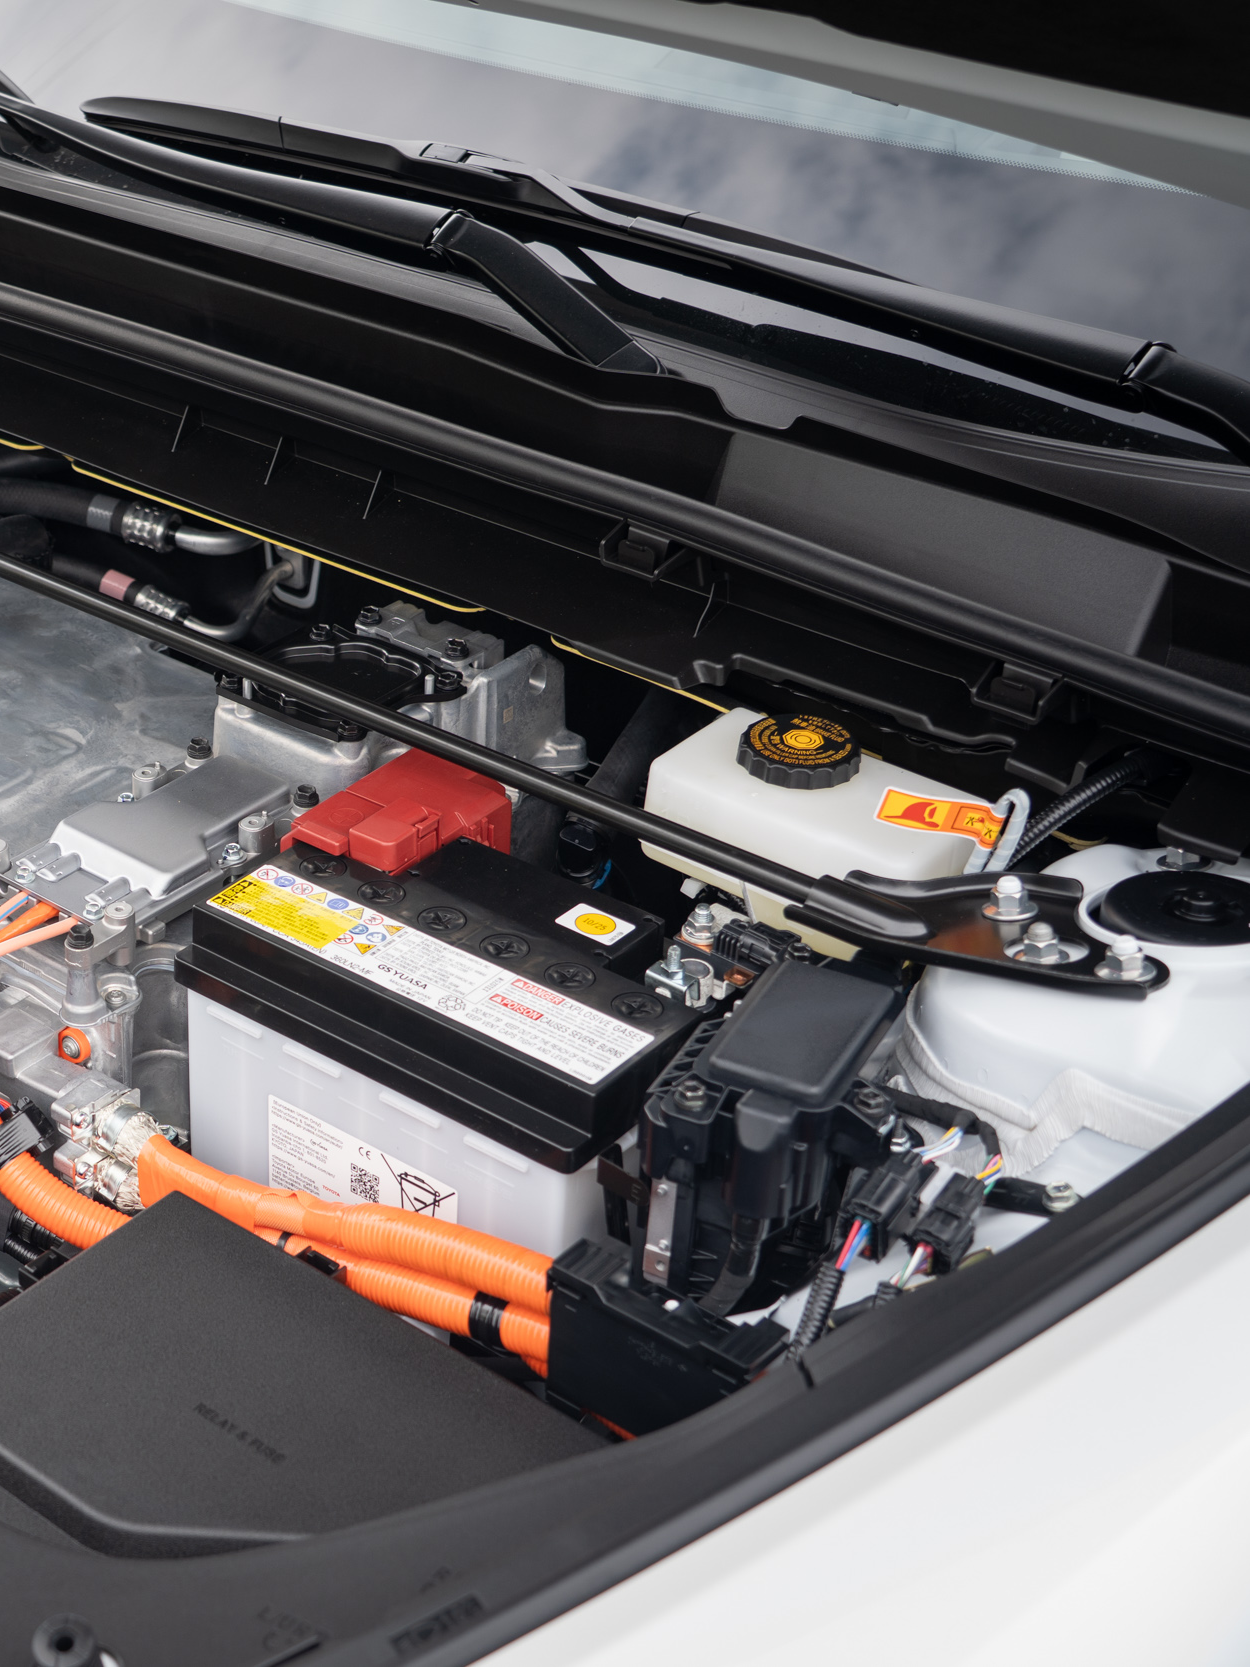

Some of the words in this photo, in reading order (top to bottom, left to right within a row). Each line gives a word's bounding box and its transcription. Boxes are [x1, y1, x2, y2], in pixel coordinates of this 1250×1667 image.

[376, 963, 393, 972] GS
[391, 970, 429, 989] YUASA
[463, 1011, 482, 1022] KEEP
[480, 1019, 499, 1030] VENT
[496, 1027, 518, 1039] CAPS
[515, 1036, 537, 1048] TIGHT
[549, 1052, 573, 1065] LEVEL
[499, 998, 541, 1019] POISON
[537, 1016, 571, 1033] CAUSES
[567, 1029, 599, 1046] SEVERE
[595, 1043, 625, 1058] BURNS
[521, 983, 563, 1004] DANGER
[559, 1001, 613, 1027] EXPLOSIVE
[610, 1024, 646, 1042] GASES
[322, 1184, 340, 1197] TOYOTA
